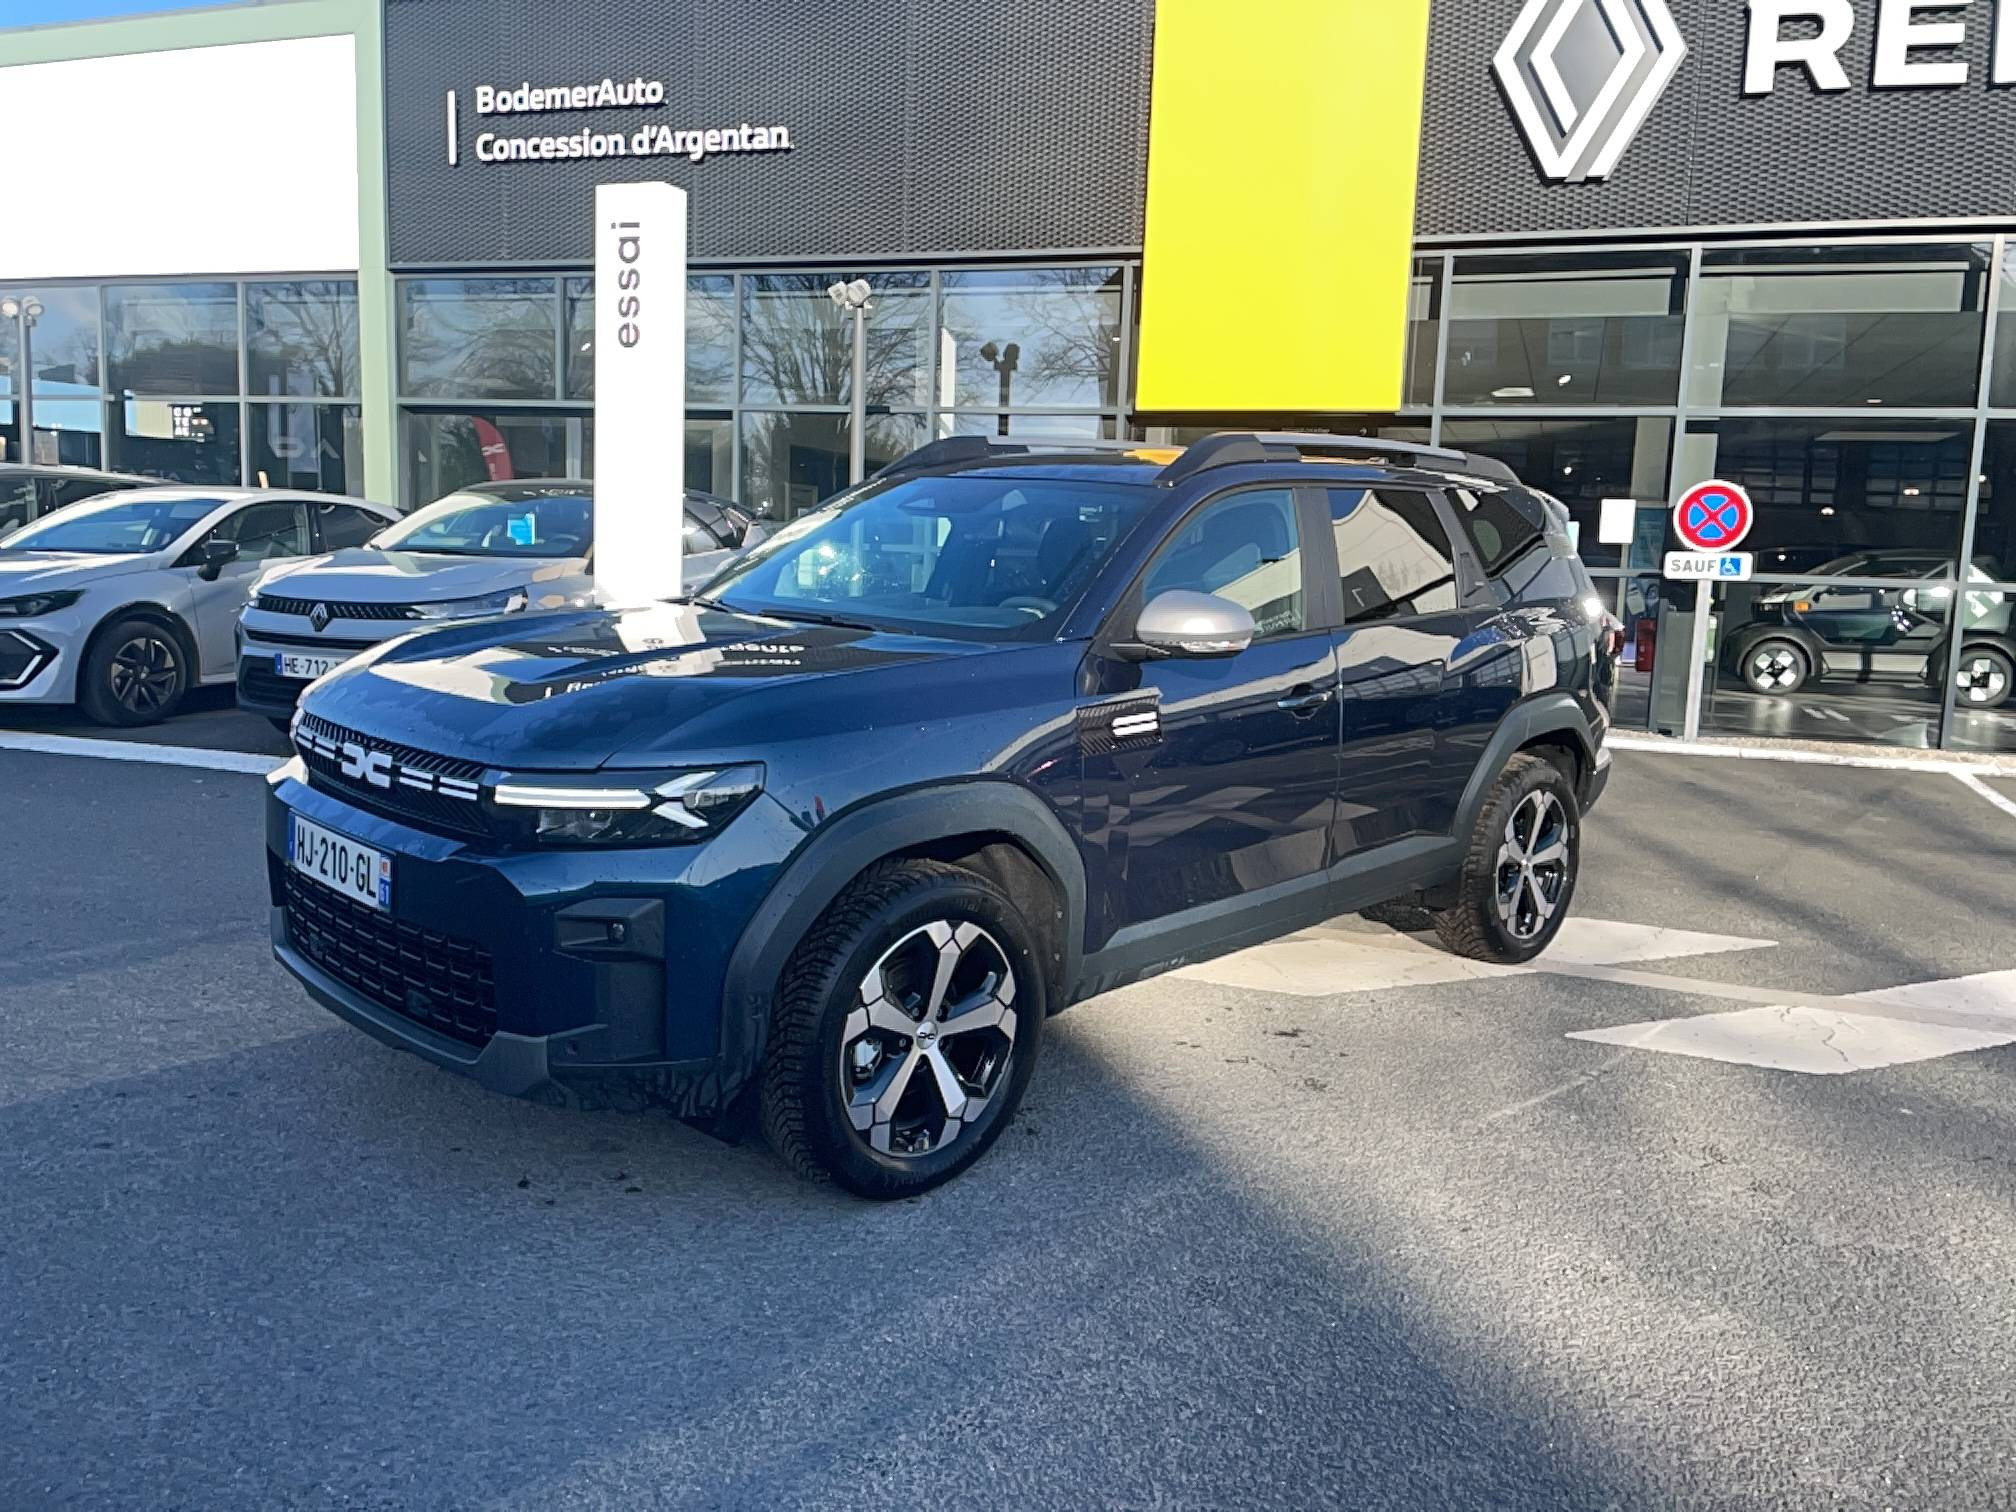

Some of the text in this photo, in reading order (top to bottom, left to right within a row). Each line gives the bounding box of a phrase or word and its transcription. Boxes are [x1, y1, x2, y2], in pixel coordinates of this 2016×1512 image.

[1744, 0, 2016, 94] RE
[475, 128, 626, 161] Concession
[611, 222, 641, 348] essai
[1671, 559, 1717, 572] SAUF
[297, 826, 377, 898] HJ-210-GL
